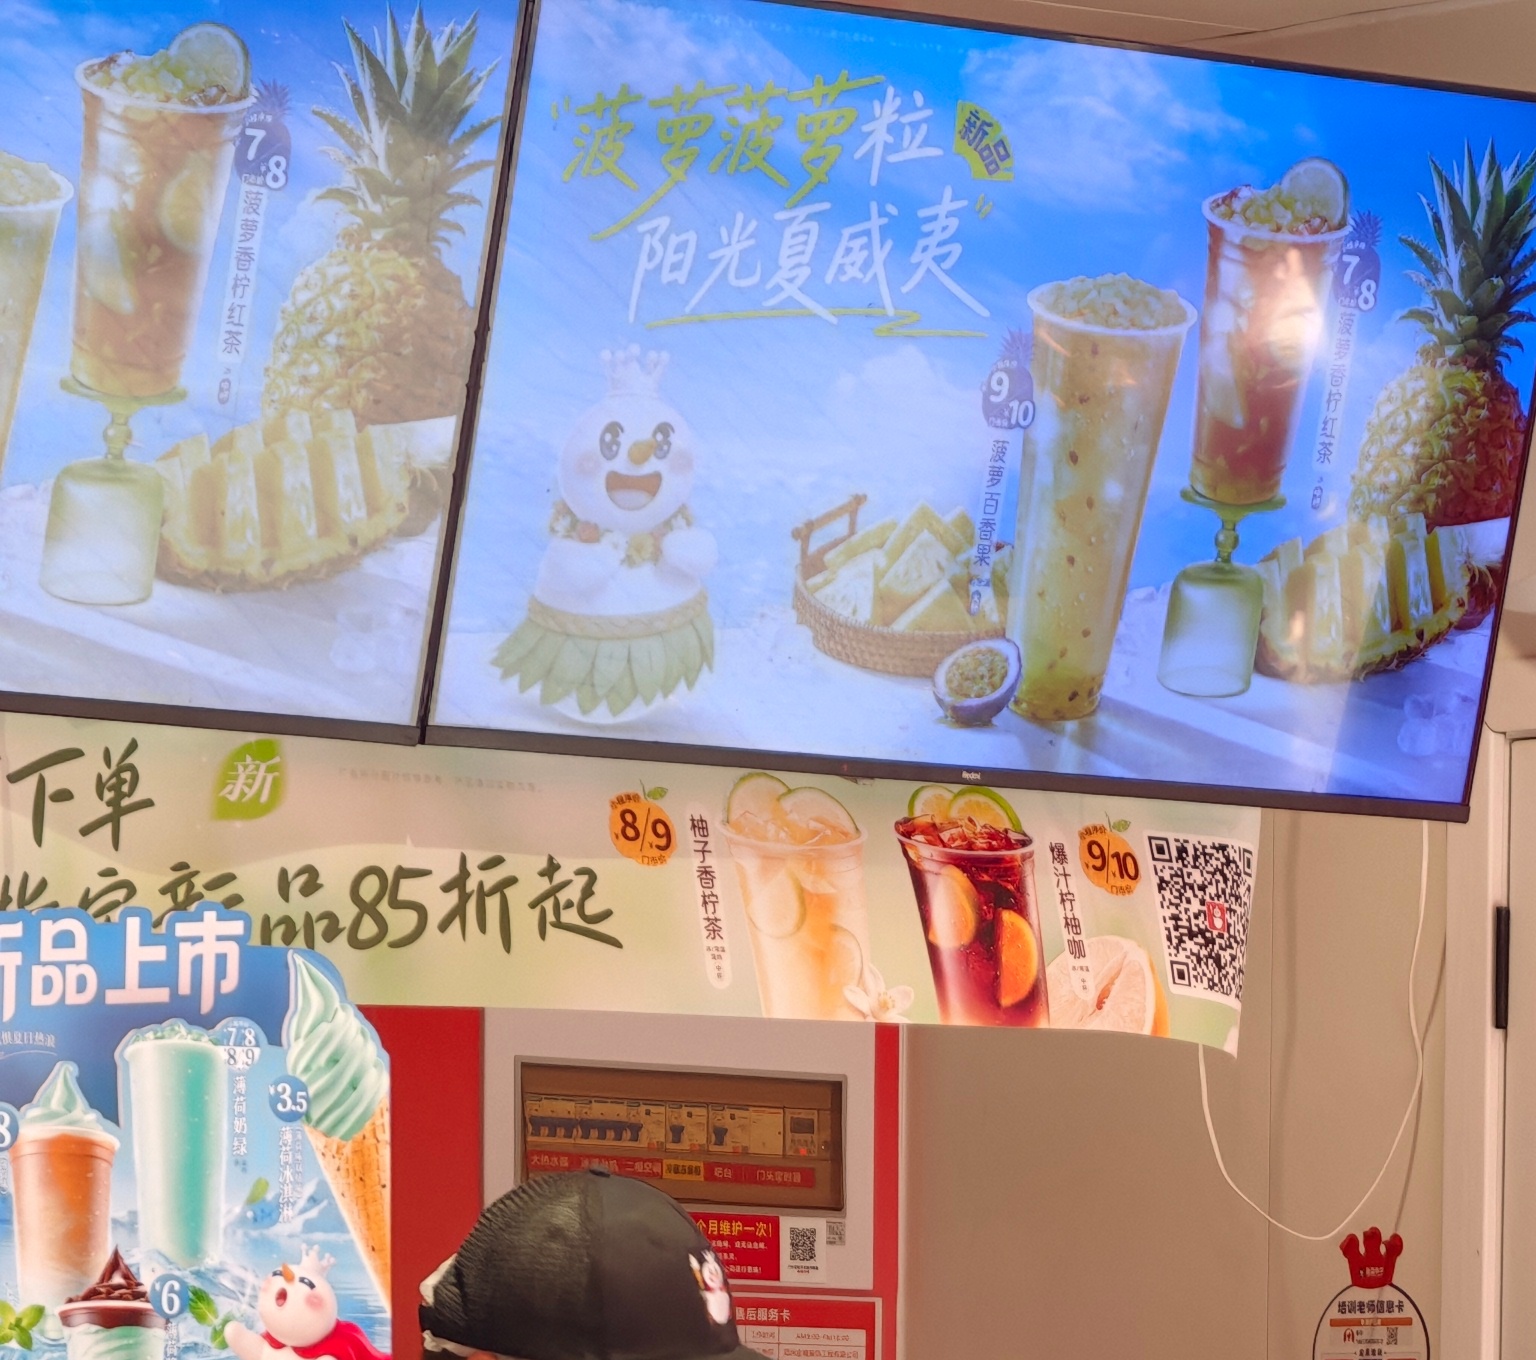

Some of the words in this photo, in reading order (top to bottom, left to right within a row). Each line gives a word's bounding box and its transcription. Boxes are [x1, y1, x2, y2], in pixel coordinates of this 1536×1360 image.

[957, 109, 1011, 177] 新品
[6, 736, 155, 852] 下单
[219, 754, 282, 804] 新
[689, 813, 724, 941] 柚子香柠茶
[1048, 841, 1087, 960] 爆汁柠柚咖
[232, 1075, 248, 1157] 薄荷奶绿
[1336, 1299, 1405, 1315] 培训老师信息卡
